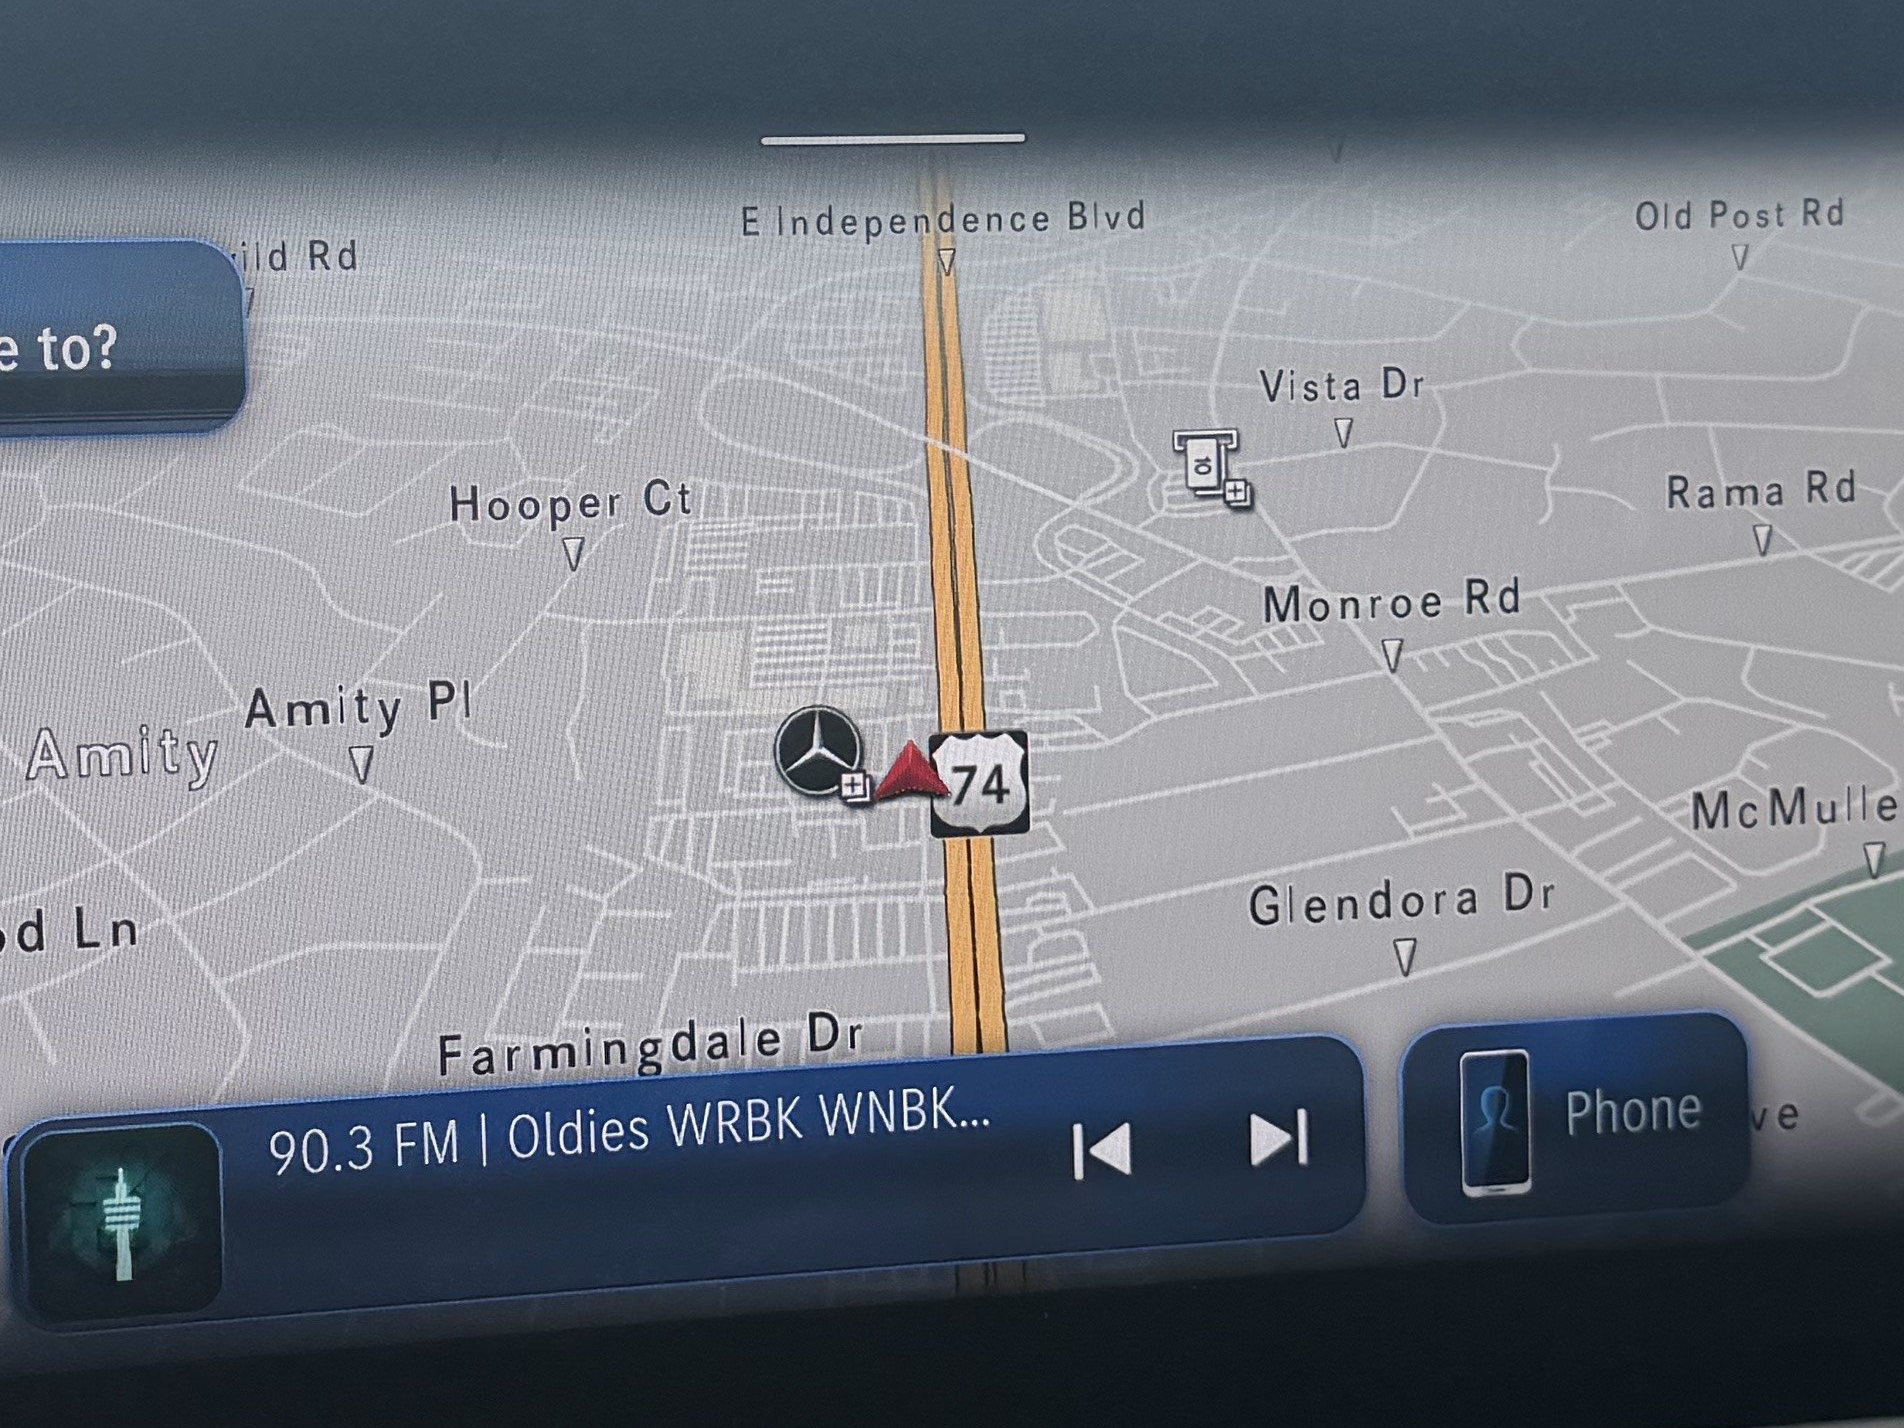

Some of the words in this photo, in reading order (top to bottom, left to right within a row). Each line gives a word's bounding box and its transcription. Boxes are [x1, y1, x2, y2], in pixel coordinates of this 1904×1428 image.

[742, 208, 760, 237] E
[777, 204, 1050, 244] Independence
[1069, 200, 1147, 232] Blvd
[1635, 200, 1692, 232] Old
[1709, 199, 1784, 231] Post
[1802, 197, 1845, 228] Rd
[231, 240, 287, 272] ild
[309, 239, 357, 271] Rd
[37, 324, 119, 372] to?
[1260, 369, 1362, 404] Vista
[1382, 367, 1426, 402] Dr
[451, 483, 623, 531] Hooper
[644, 479, 692, 519] Ct
[1667, 474, 1785, 512] Rama
[1806, 470, 1856, 506] Rd
[1263, 583, 1443, 625] Monroe
[1465, 578, 1521, 616] Rd
[245, 687, 402, 737] Amity
[429, 679, 472, 721] Pl
[26, 725, 219, 792] Amity
[952, 766, 1010, 809] 74
[1249, 878, 1479, 927] Glendora
[1505, 872, 1557, 914] Dr
[77, 907, 138, 949] Ln
[439, 1018, 782, 1078] Farmingdale
[808, 1011, 863, 1054] Dr
[1567, 1088, 1701, 1136] Phone
[269, 1126, 373, 1175] 90.3
[396, 1119, 458, 1168] FM
[507, 1109, 650, 1161] Oldies
[667, 1099, 803, 1148] WRBK
